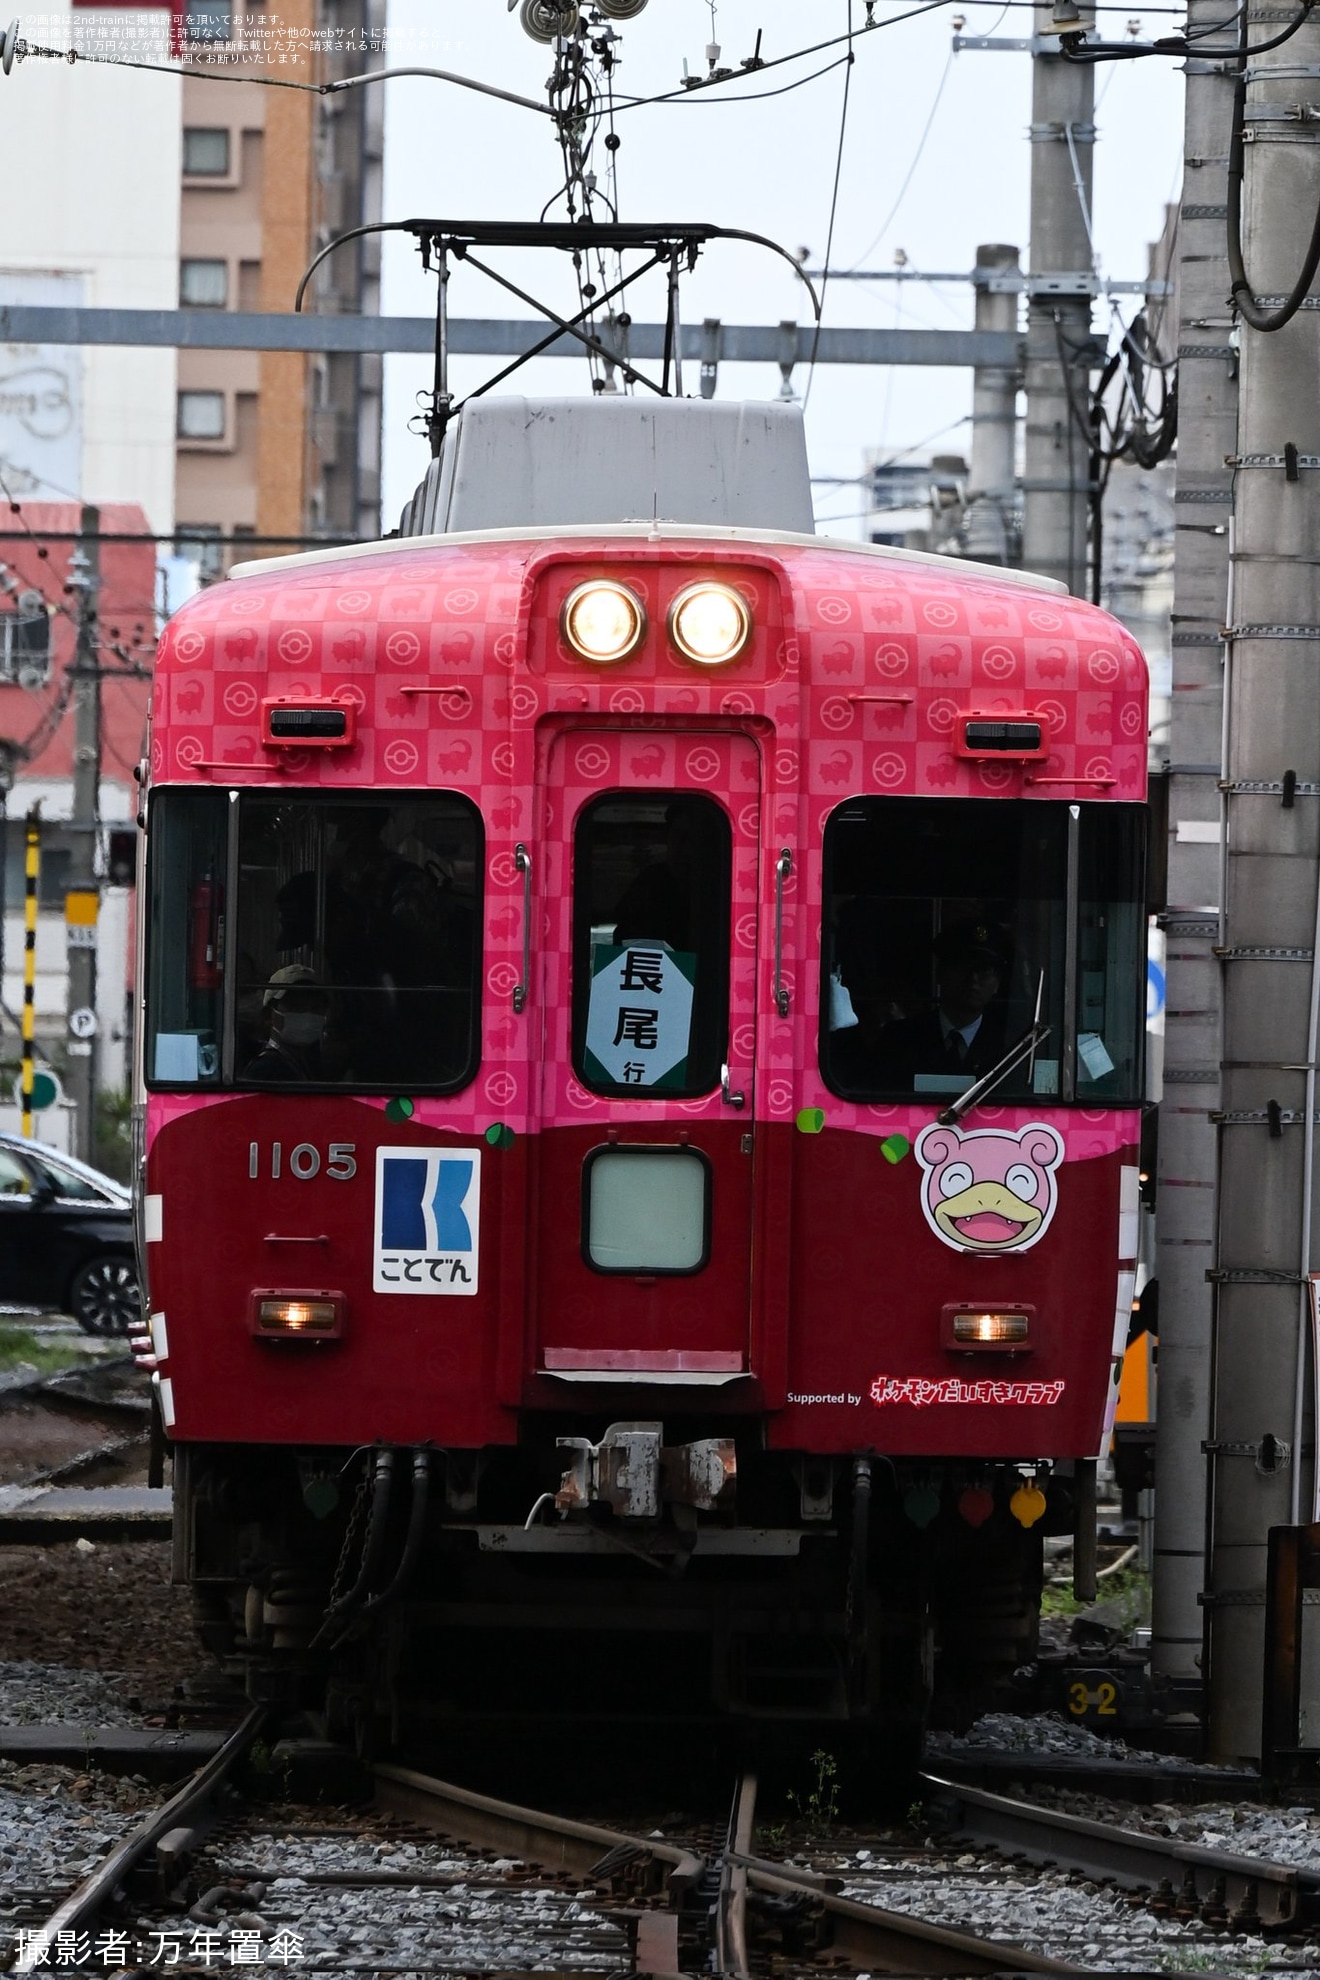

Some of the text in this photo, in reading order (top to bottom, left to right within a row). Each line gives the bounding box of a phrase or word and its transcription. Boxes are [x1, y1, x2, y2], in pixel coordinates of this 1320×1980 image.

[248, 1141, 358, 1180] 1105
[380, 1257, 473, 1283] ことでん
[786, 1392, 862, 1406] Supported by
[869, 1376, 1066, 1406] ポケモンだいすきクラブ
[1068, 1682, 1117, 1715] 3-2
